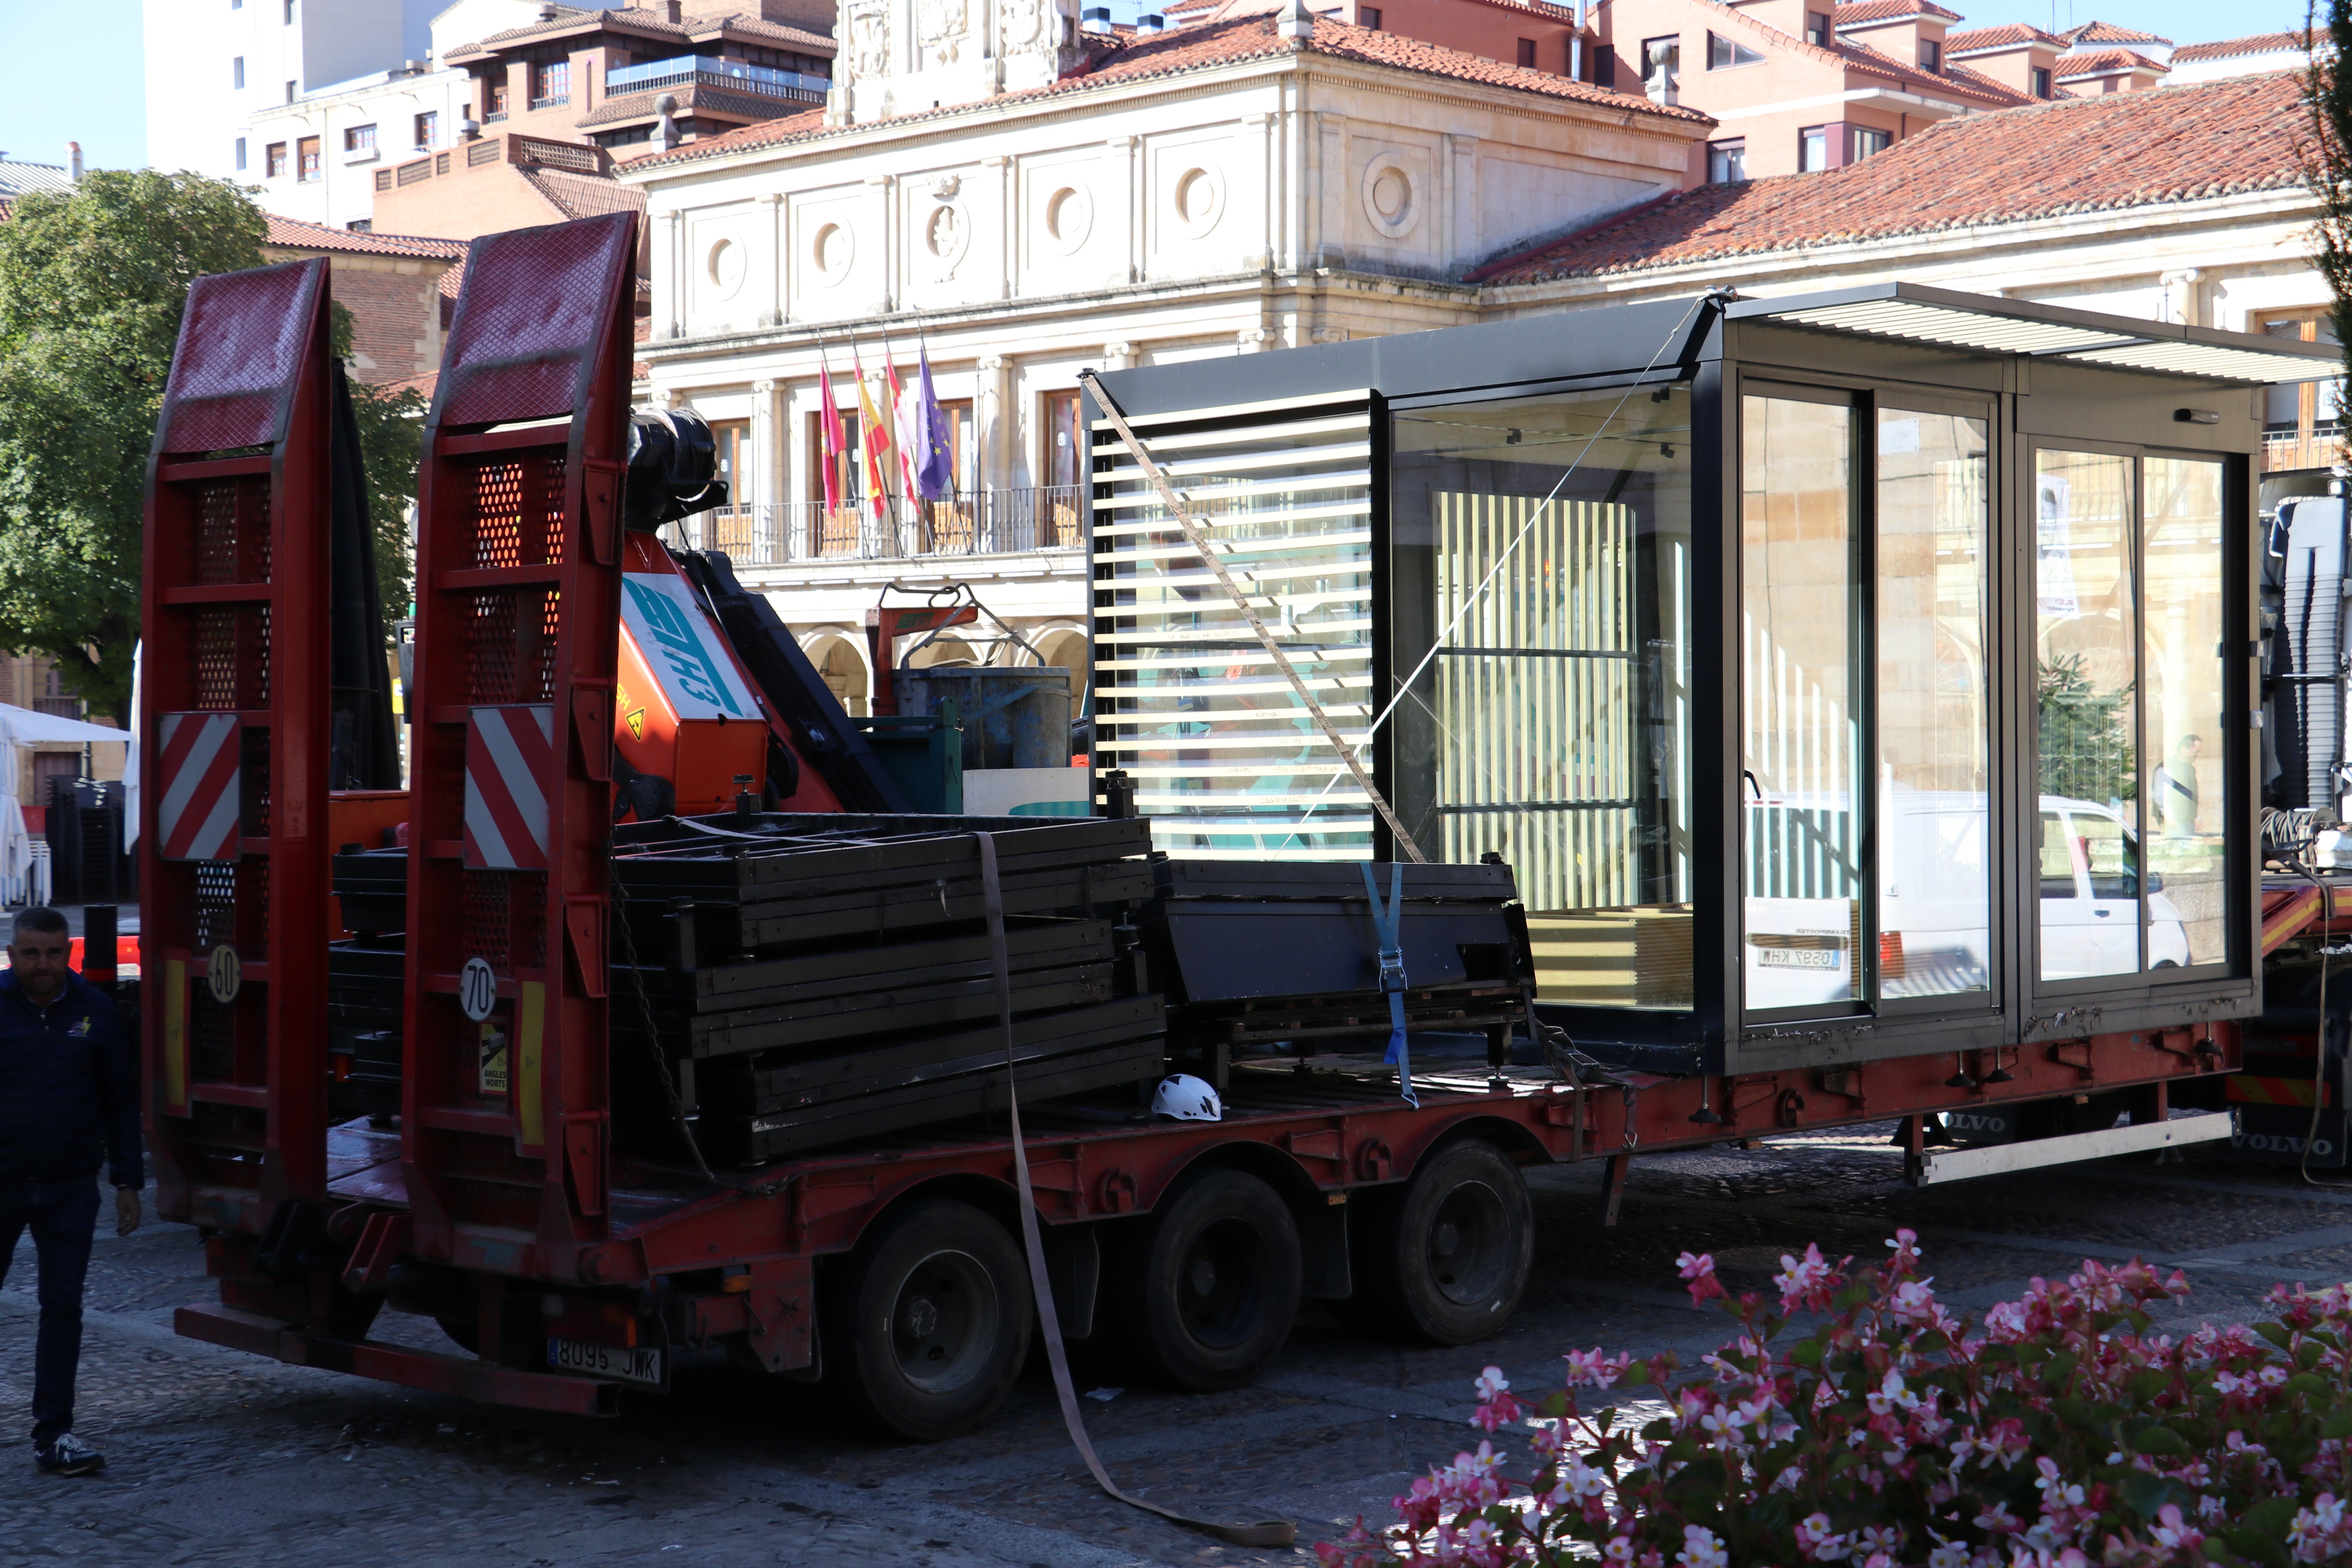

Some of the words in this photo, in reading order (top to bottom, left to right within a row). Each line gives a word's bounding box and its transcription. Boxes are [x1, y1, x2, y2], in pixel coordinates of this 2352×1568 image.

[215, 950, 233, 996] 60
[467, 965, 489, 1013] 70
[484, 1070, 506, 1080] ANGLES
[485, 1078, 505, 1088] MORTS
[1944, 1112, 2006, 1132] OLVO
[2229, 1133, 2333, 1156] VOLVO
[559, 1340, 608, 1370] 8095
[622, 1349, 656, 1380] JWK
